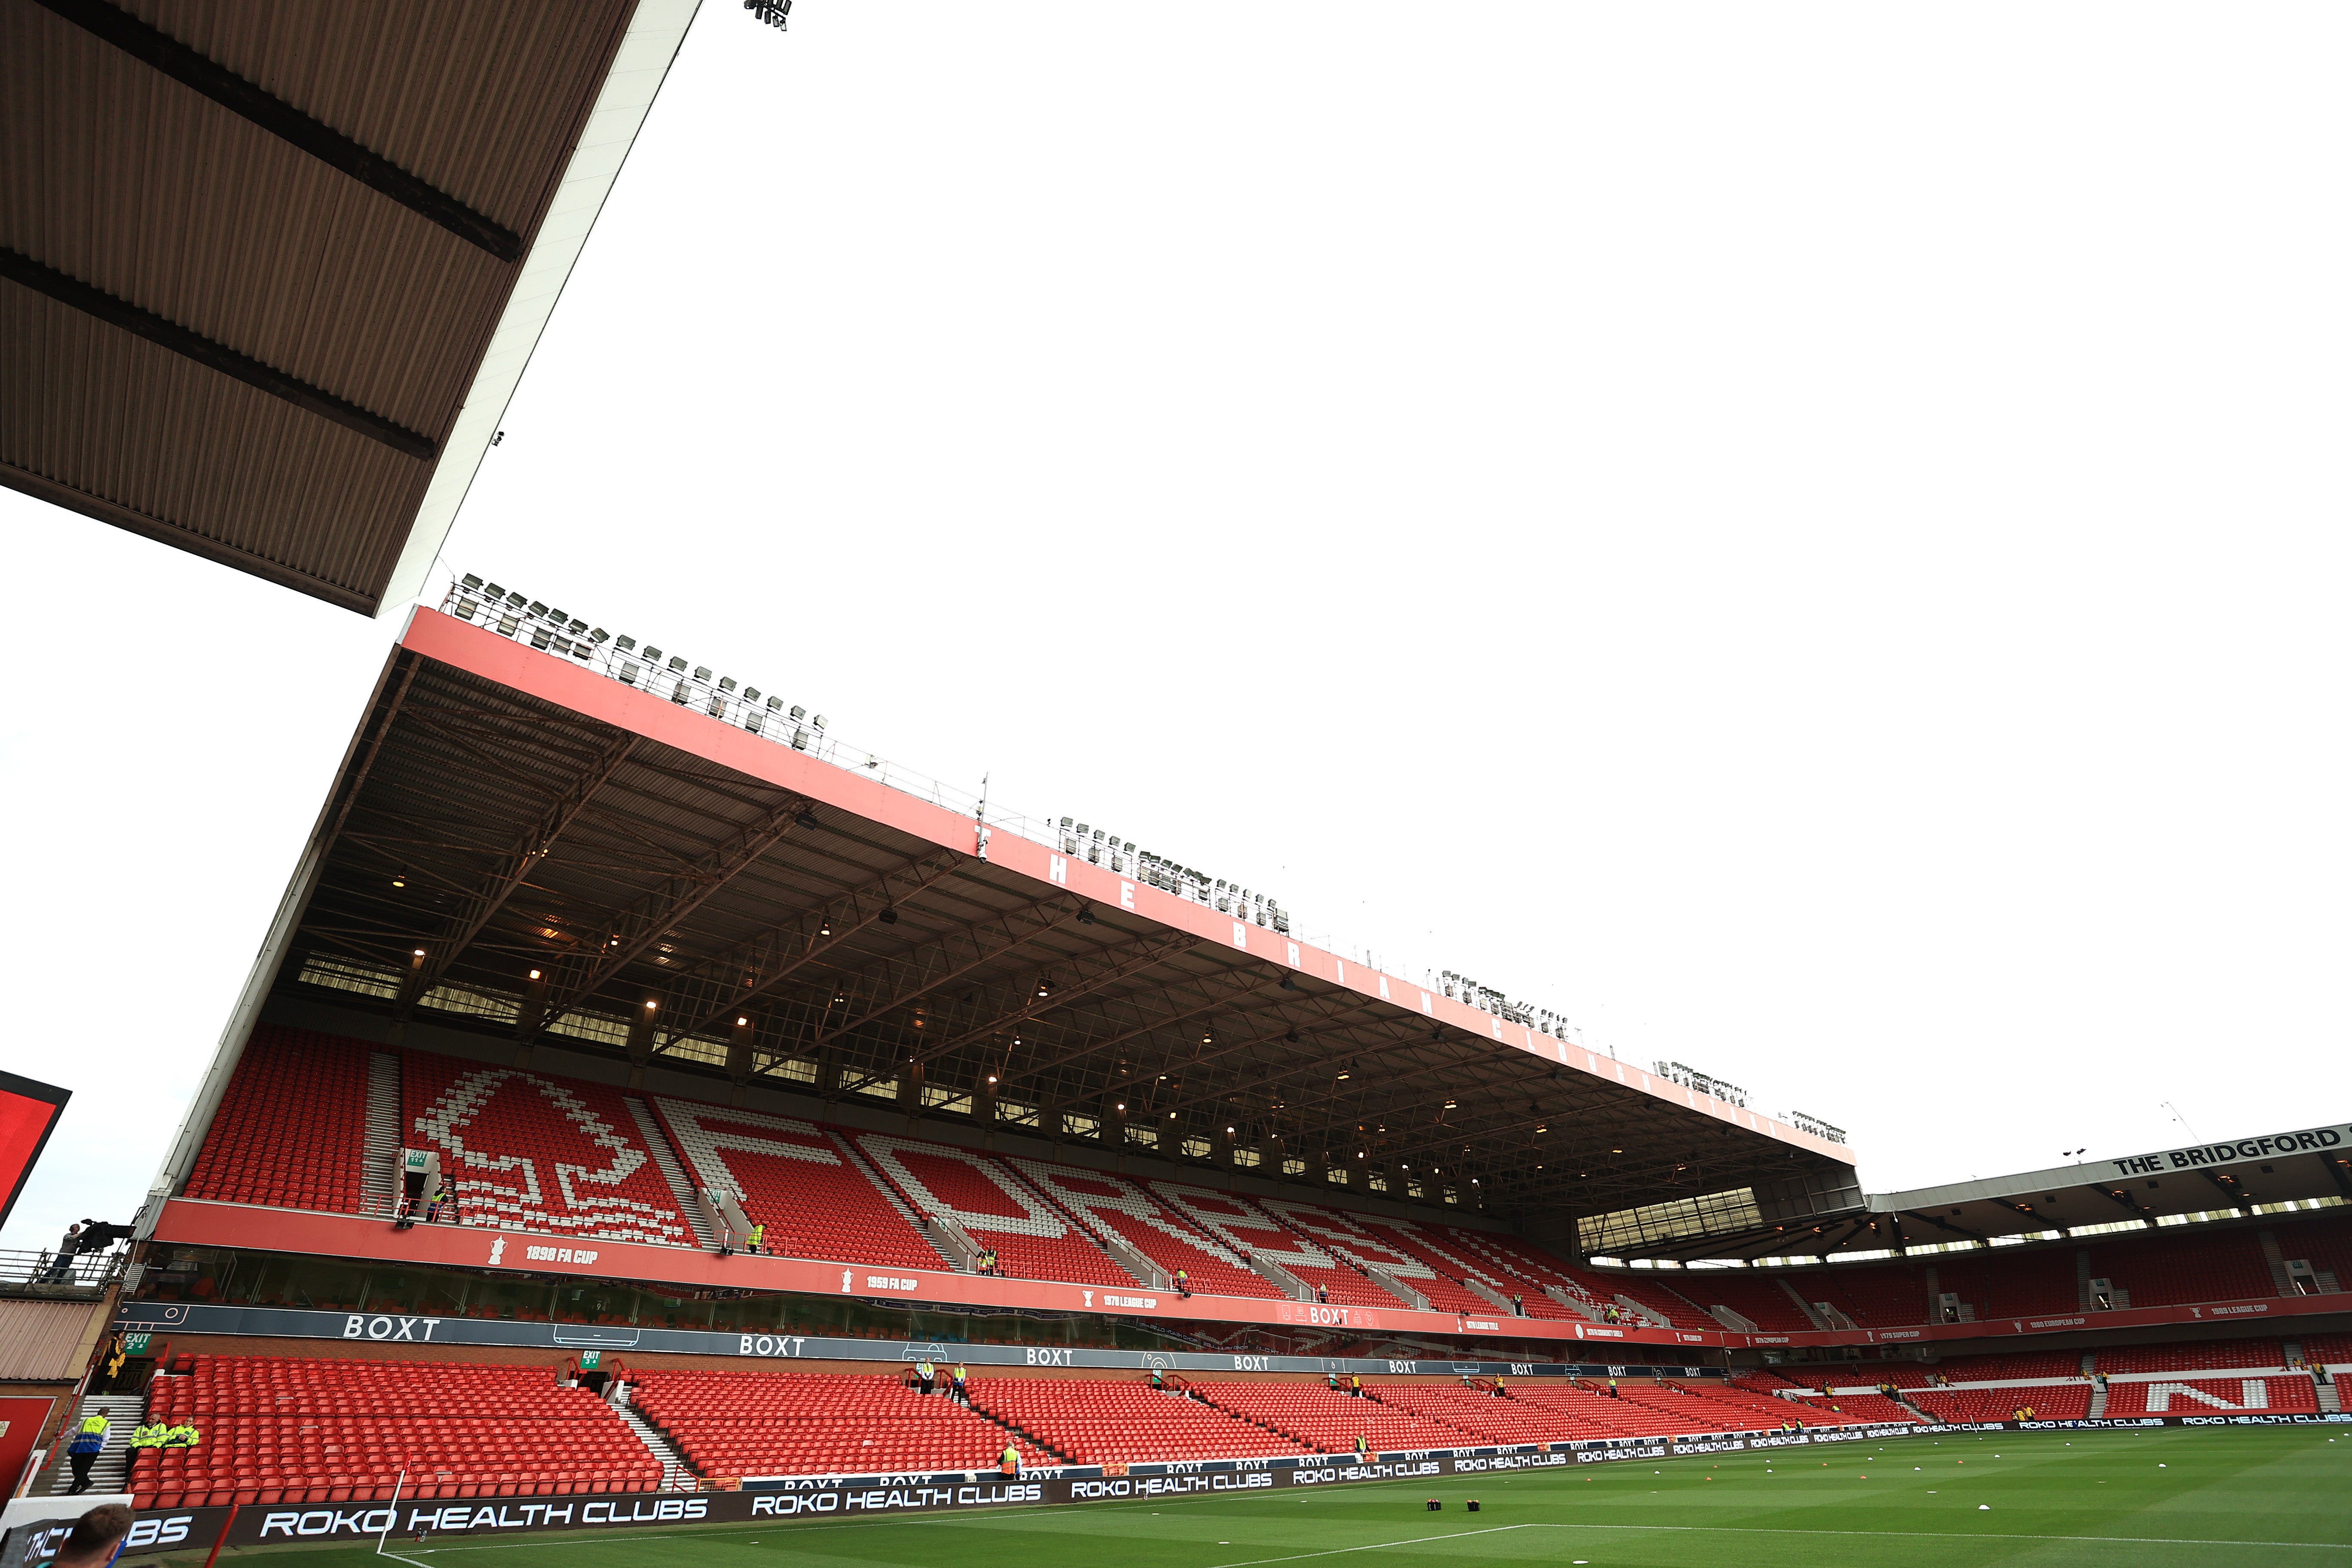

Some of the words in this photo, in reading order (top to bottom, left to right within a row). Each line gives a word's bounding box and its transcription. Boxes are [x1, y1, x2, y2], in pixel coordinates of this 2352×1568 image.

[974, 824, 1135, 909] THE
[1233, 921, 1433, 1015] BRIAN
[1491, 1018, 1652, 1092] CLOUGH
[1687, 1090, 1776, 1137] STAND
[410, 1151, 427, 1159] EXIT
[2113, 1155, 2165, 1175] THE
[2168, 1129, 2341, 1168] BRIDGFORD
[526, 1245, 557, 1261] 1898
[557, 1248, 572, 1263] FA
[573, 1250, 598, 1265] CUP
[867, 1276, 888, 1289] 1959
[889, 1277, 900, 1290] FA
[900, 1279, 918, 1291] CUP
[1103, 1295, 1120, 1306] 1978
[1120, 1296, 1144, 1308] LEAGUE
[1144, 1298, 1157, 1309] CUP
[1310, 1307, 1348, 1325] BOXT
[2228, 1305, 2255, 1314] LEAGUE
[343, 1315, 441, 1341] BOXT
[2043, 1319, 2074, 1327] EUROPEAN
[126, 1333, 151, 1343] EXIT
[740, 1335, 805, 1356] BOXT
[583, 1351, 600, 1359] EXIT
[1027, 1348, 1073, 1366] BOXT
[1234, 1356, 1269, 1370] BOXT
[1389, 1360, 1416, 1373] BOXT
[1511, 1364, 1533, 1375] BOXT
[1608, 1366, 1626, 1376] BOXT
[1685, 1367, 1701, 1377] BOXT
[2058, 1419, 2112, 1427] HEALTH
[2182, 1417, 2226, 1425] ROKO
[2228, 1415, 2291, 1424] HEALTH
[2294, 1413, 2352, 1423] CLUBS
[1928, 1424, 1960, 1433] HEALTH
[1673, 1444, 1694, 1455] ROKO
[1694, 1442, 1721, 1453] HEALTH
[1721, 1440, 1744, 1450] CLUBS
[1750, 1438, 1768, 1448] ROKO
[1767, 1436, 1790, 1446] HEALTH
[1789, 1435, 1809, 1444] CLUBS
[1577, 1450, 1603, 1463] ROKO
[1603, 1448, 1637, 1460] HEALTH
[1637, 1446, 1665, 1458] CLUBS
[1455, 1458, 1487, 1472] ROKO
[1488, 1455, 1530, 1469] HEALTH
[1531, 1453, 1566, 1466] CLUBS
[1293, 1468, 1335, 1484] ROKO
[1338, 1464, 1393, 1480] HEALTH
[1395, 1461, 1440, 1476] CLUBS
[1071, 1480, 1130, 1498] ROKO
[1135, 1476, 1208, 1494] HEALTH
[1213, 1473, 1272, 1489] CLUBS
[752, 1493, 839, 1516] ROKO
[845, 1488, 952, 1510] HEALTH
[957, 1484, 1042, 1504] CLUBS
[259, 1510, 398, 1537] ROKO
[407, 1503, 574, 1531] HEALTH
[582, 1498, 709, 1522] CLUBS
